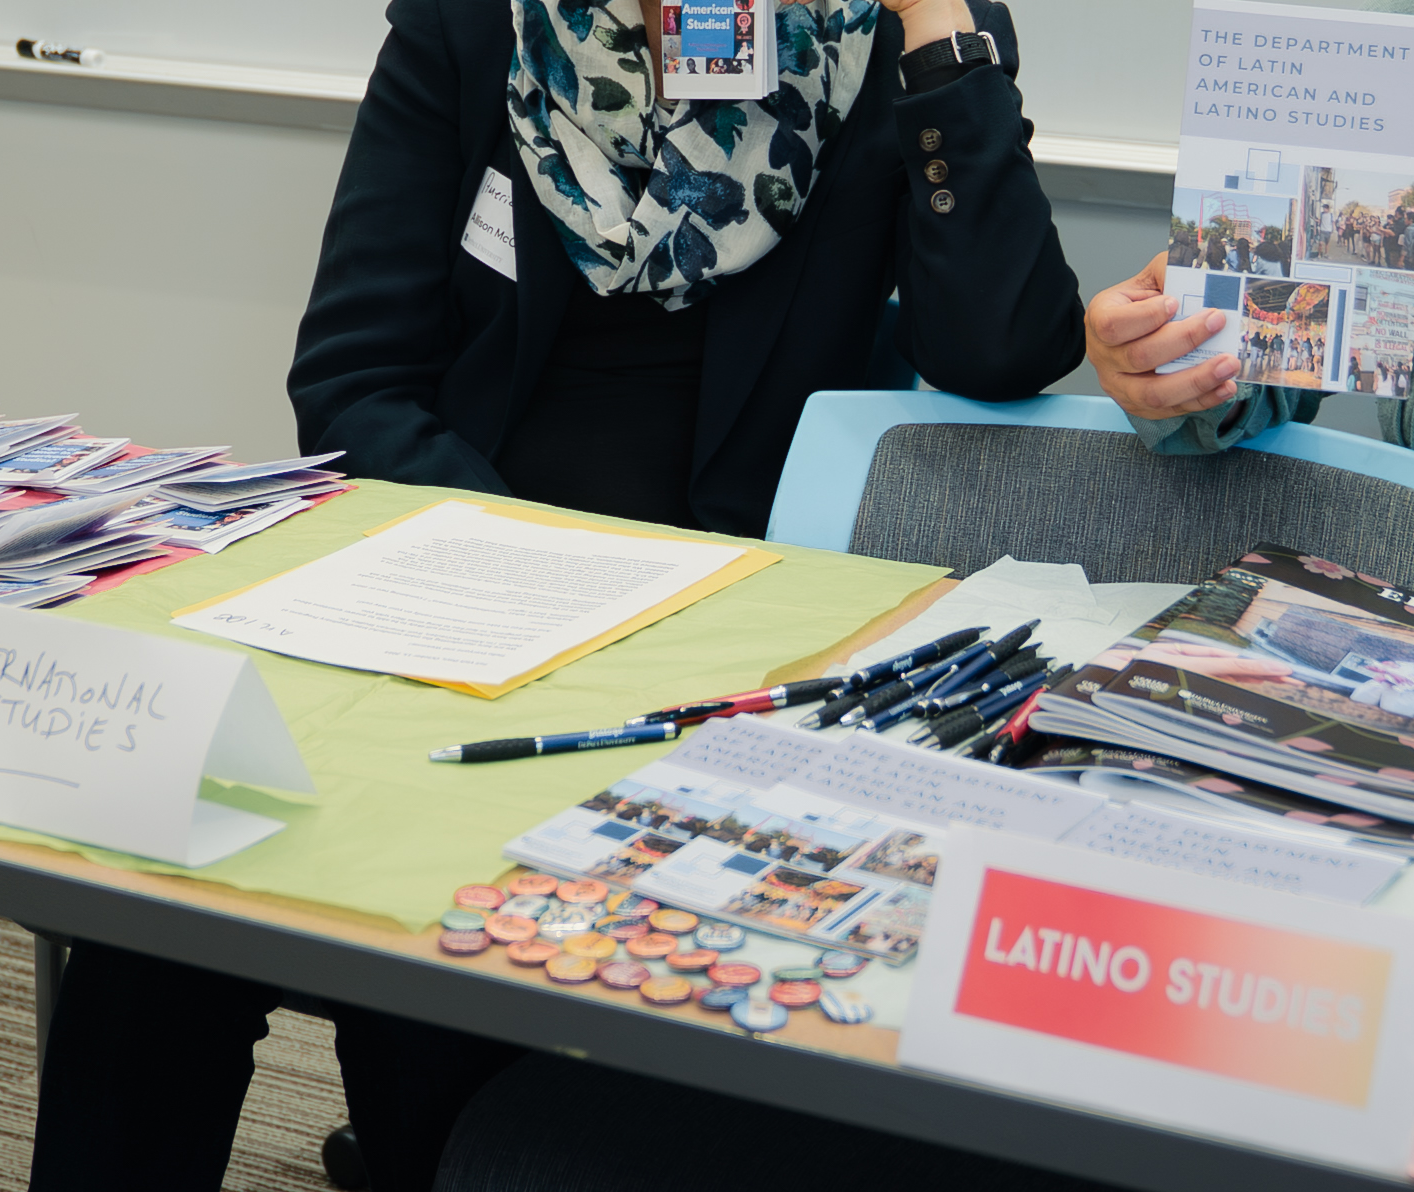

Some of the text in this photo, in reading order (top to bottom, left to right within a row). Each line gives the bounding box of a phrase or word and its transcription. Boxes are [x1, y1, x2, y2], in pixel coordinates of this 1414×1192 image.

[682, 4, 734, 15] American
[686, 18, 730, 30] Studies!
[1200, 28, 1412, 61] THE DEPARTMENT
[1198, 53, 1304, 76] OF LATIN
[1195, 77, 1376, 107] AMERICAN AND
[1193, 101, 1386, 132] LATINO STUDIES
[1388, 329, 1409, 338] WALL
[873, 765, 945, 788] LATIN
[900, 759, 1062, 805] DEPARTMENT
[983, 916, 1365, 1043] LATINO STUDIES
